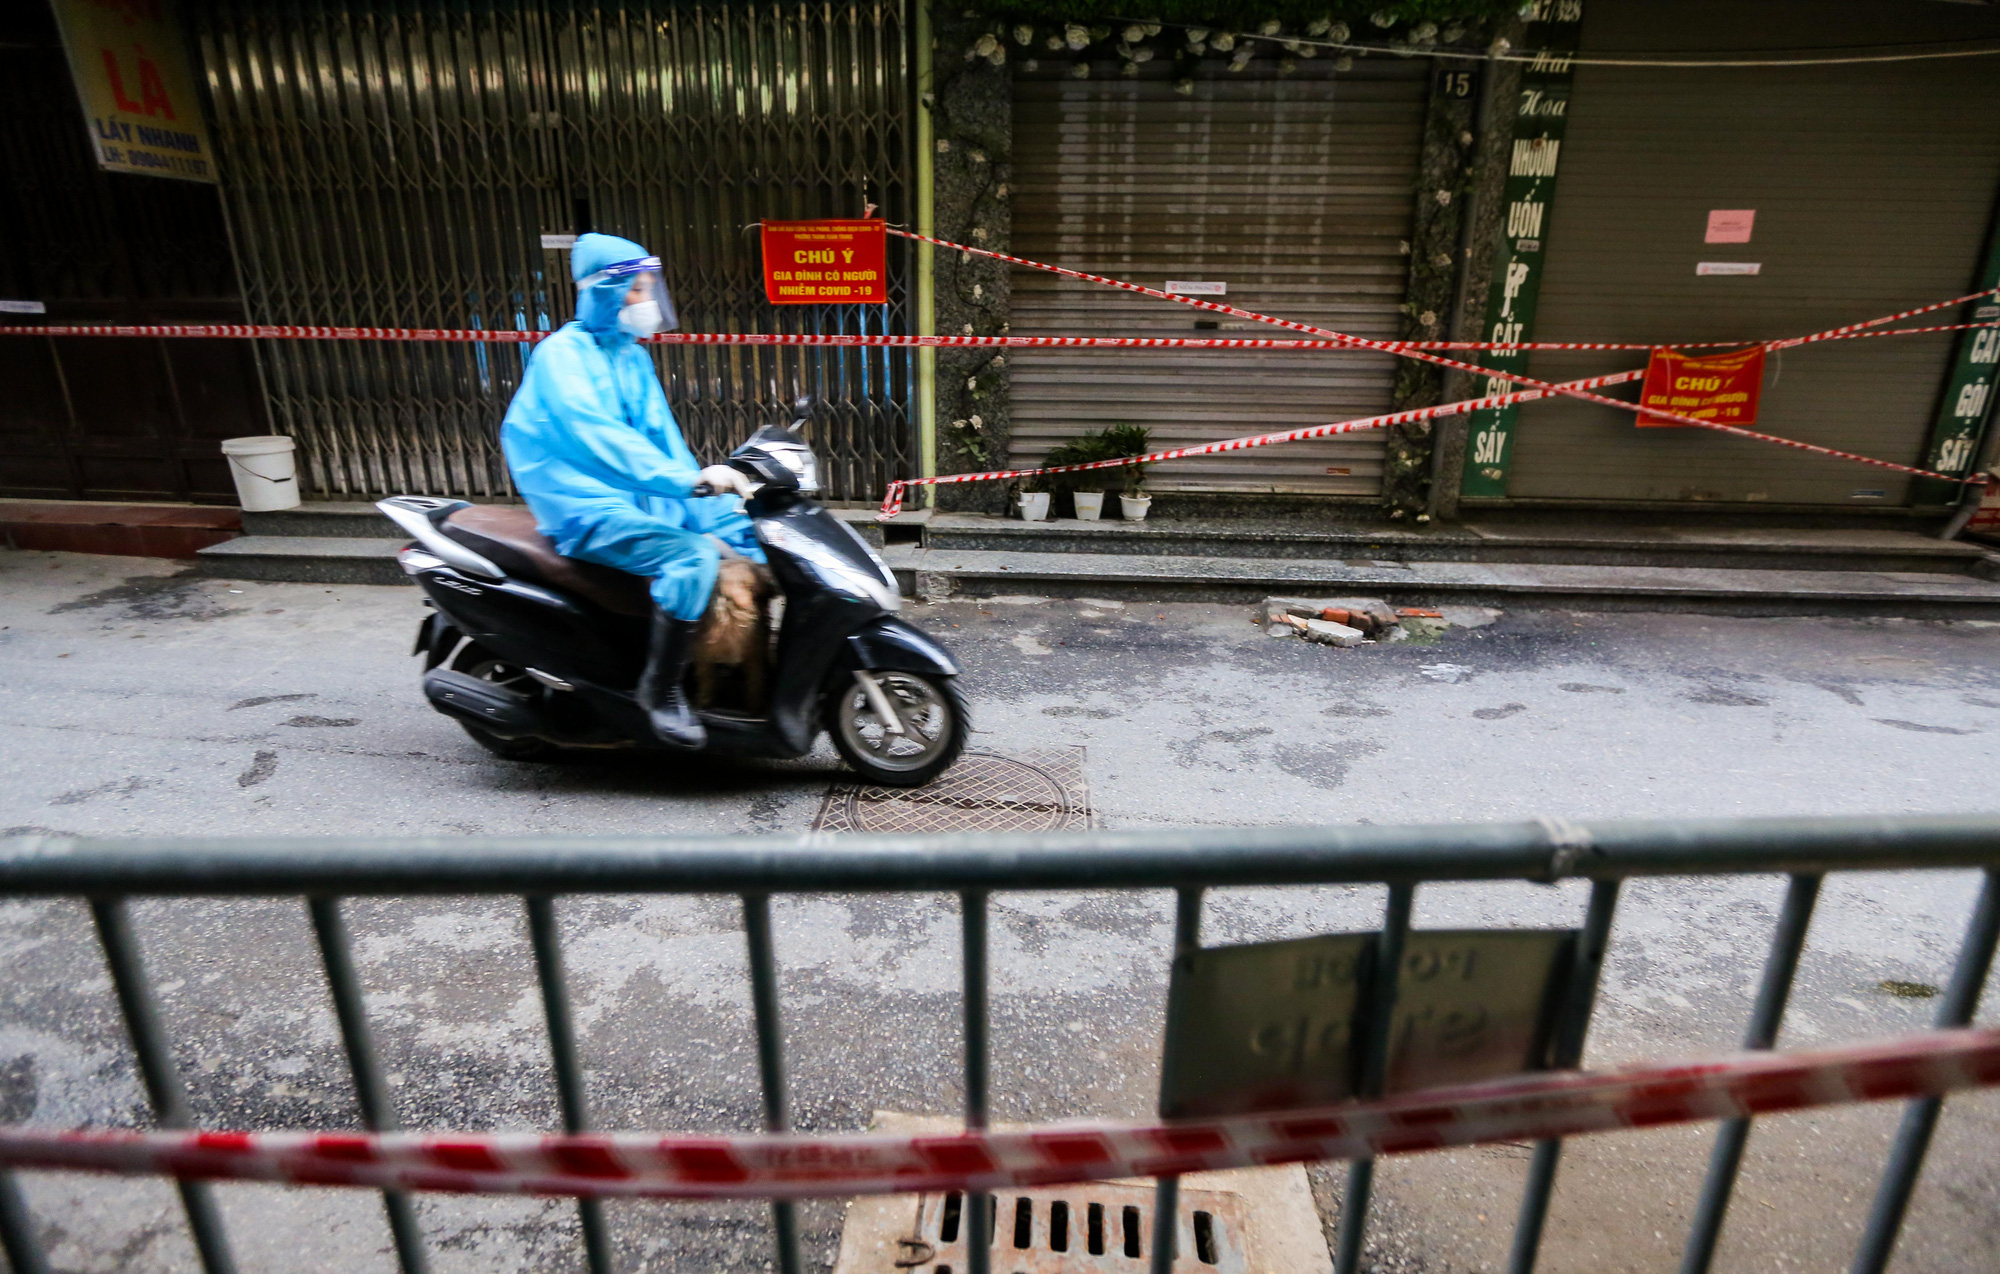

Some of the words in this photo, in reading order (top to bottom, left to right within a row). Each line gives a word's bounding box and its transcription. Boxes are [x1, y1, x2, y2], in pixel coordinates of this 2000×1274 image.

[101, 43, 176, 120] LÀ
[1445, 73, 1470, 97] 15
[1519, 90, 1566, 116] Hoa
[136, 125, 200, 153] NHANH
[1507, 188, 1545, 238] UỐN
[794, 248, 835, 264] CHÚ
[841, 248, 855, 264] Ý
[773, 271, 793, 281] GIA
[795, 269, 822, 281] ĐÌNH
[825, 270, 840, 281] CÓ
[843, 269, 877, 281] NGƯỜI
[779, 282, 816, 296] NHIỄM
[818, 286, 851, 296] COVID
[1674, 376, 1722, 391] CHÚ
[1648, 394, 1668, 405] GIA
[1474, 420, 1506, 463] SẤY
